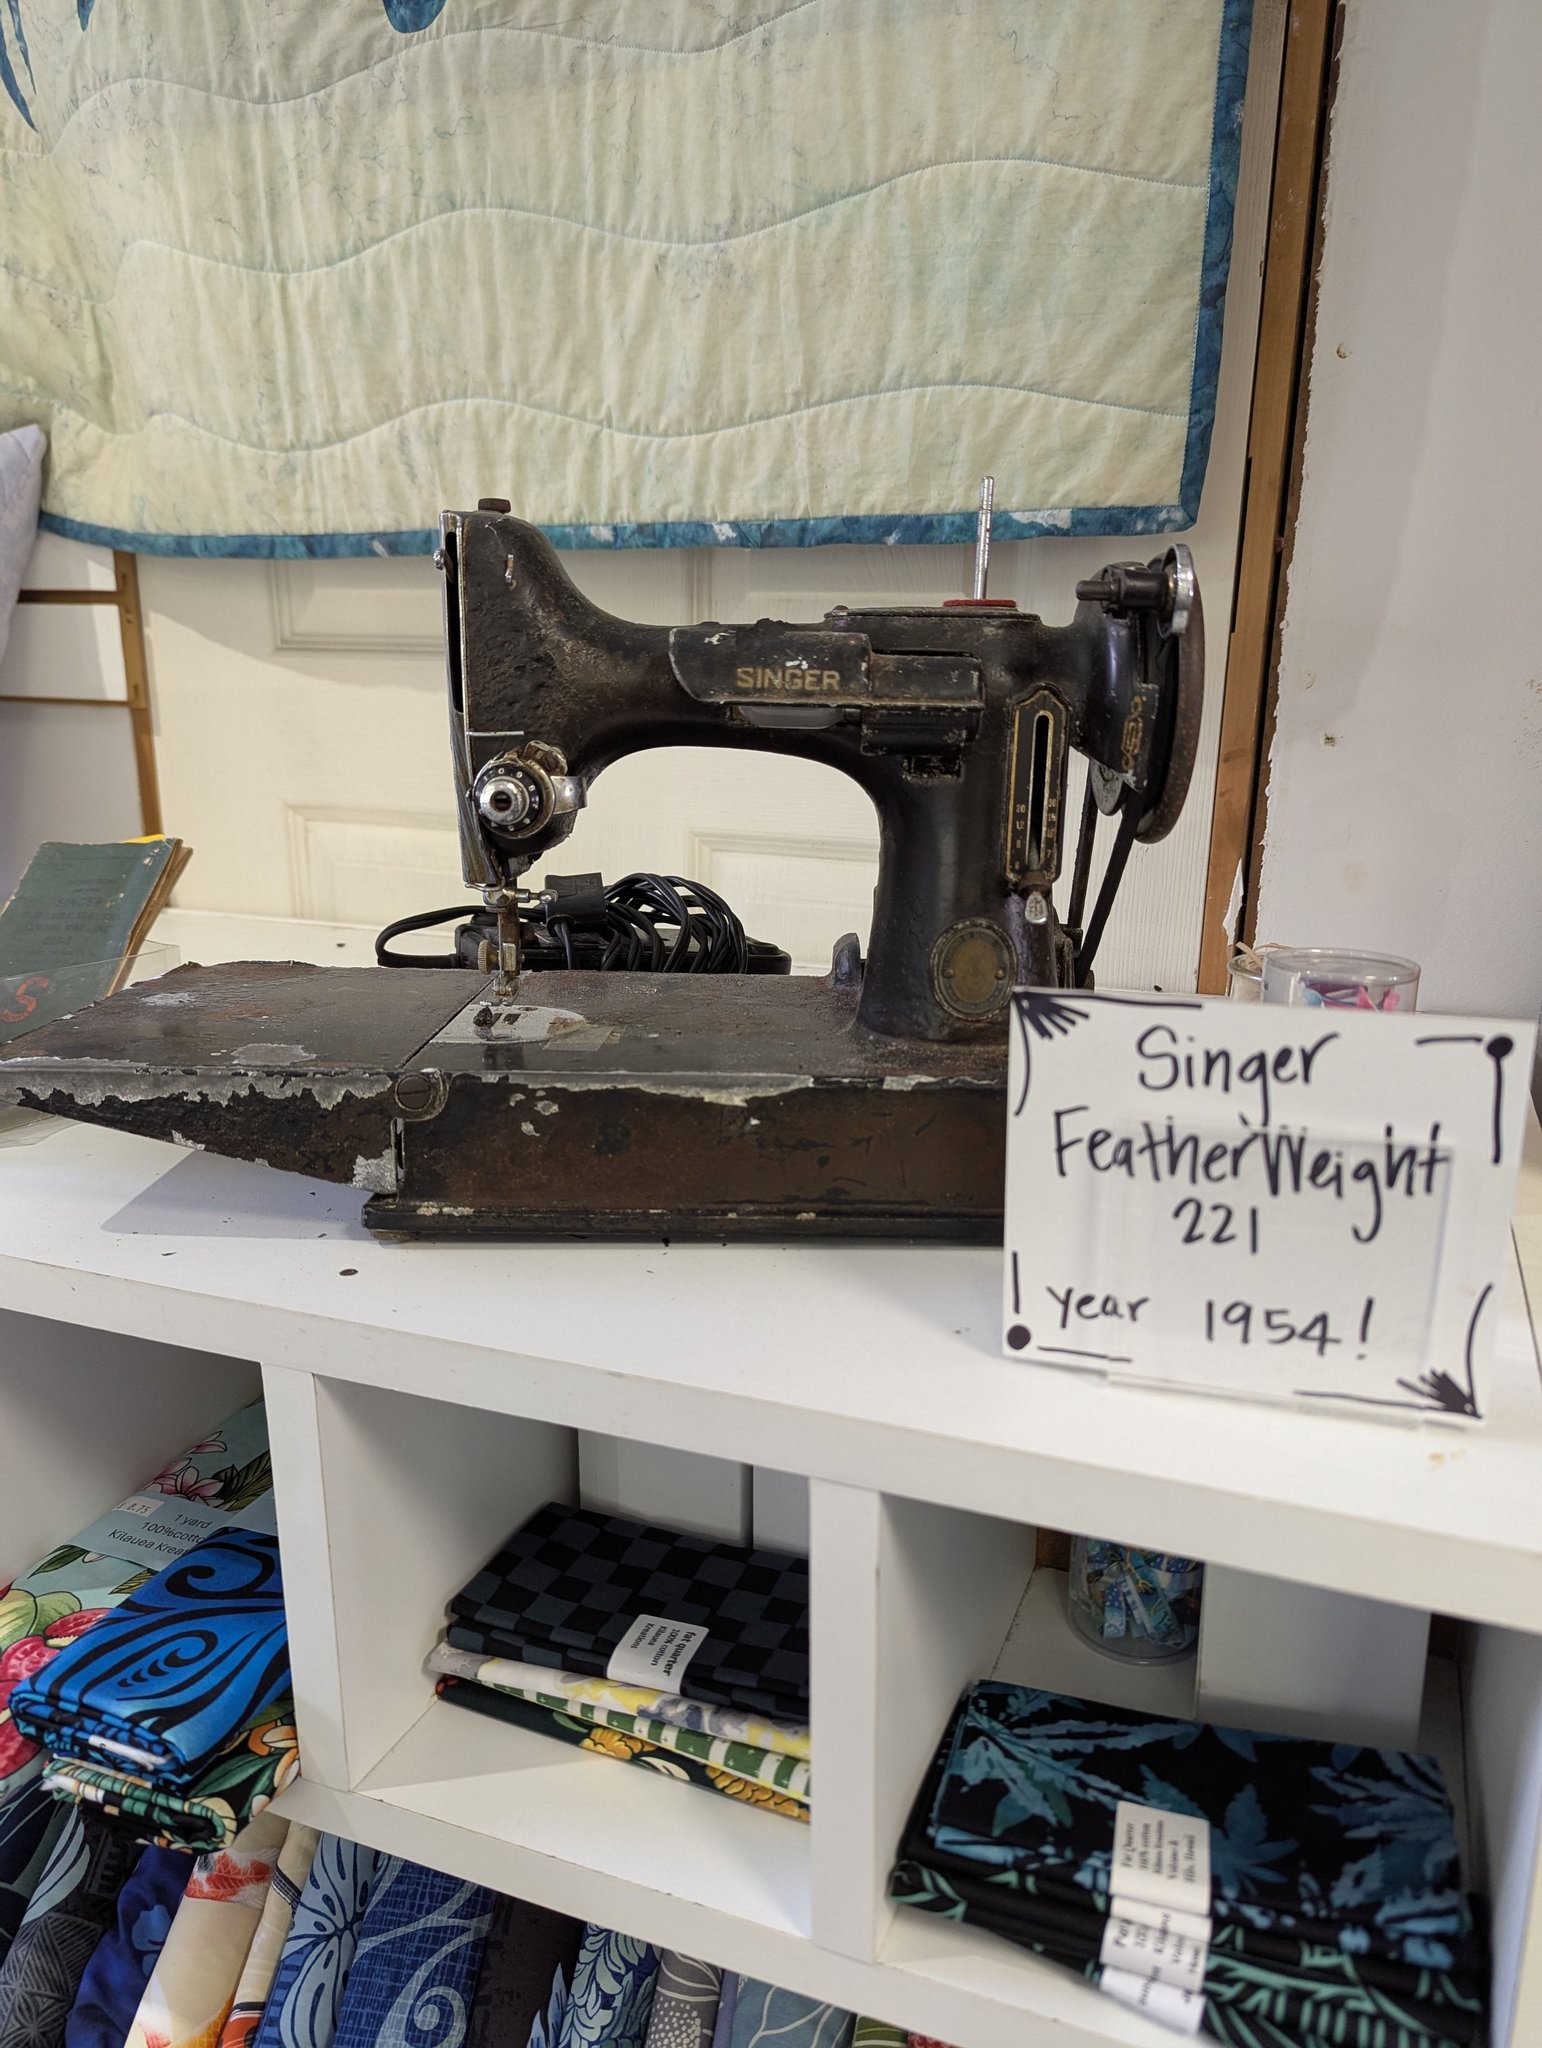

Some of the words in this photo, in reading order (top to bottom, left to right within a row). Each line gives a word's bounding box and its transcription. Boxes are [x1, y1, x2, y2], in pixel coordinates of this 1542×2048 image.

[736, 667, 840, 691] SINGER
[1136, 1025, 1341, 1127] Singer
[1053, 1105, 1453, 1244] FeatherWeight
[1172, 1197, 1259, 1255] 221
[1046, 1286, 1150, 1329] year
[1204, 1298, 1374, 1361] 1954!
[141, 1521, 206, 1543] 100%cotto
[180, 1517, 213, 1529] yard
[108, 1529, 155, 1548] Kilauea
[681, 1632, 696, 1643] fat
[651, 1645, 668, 1666] cotton
[663, 1643, 686, 1676] quarter
